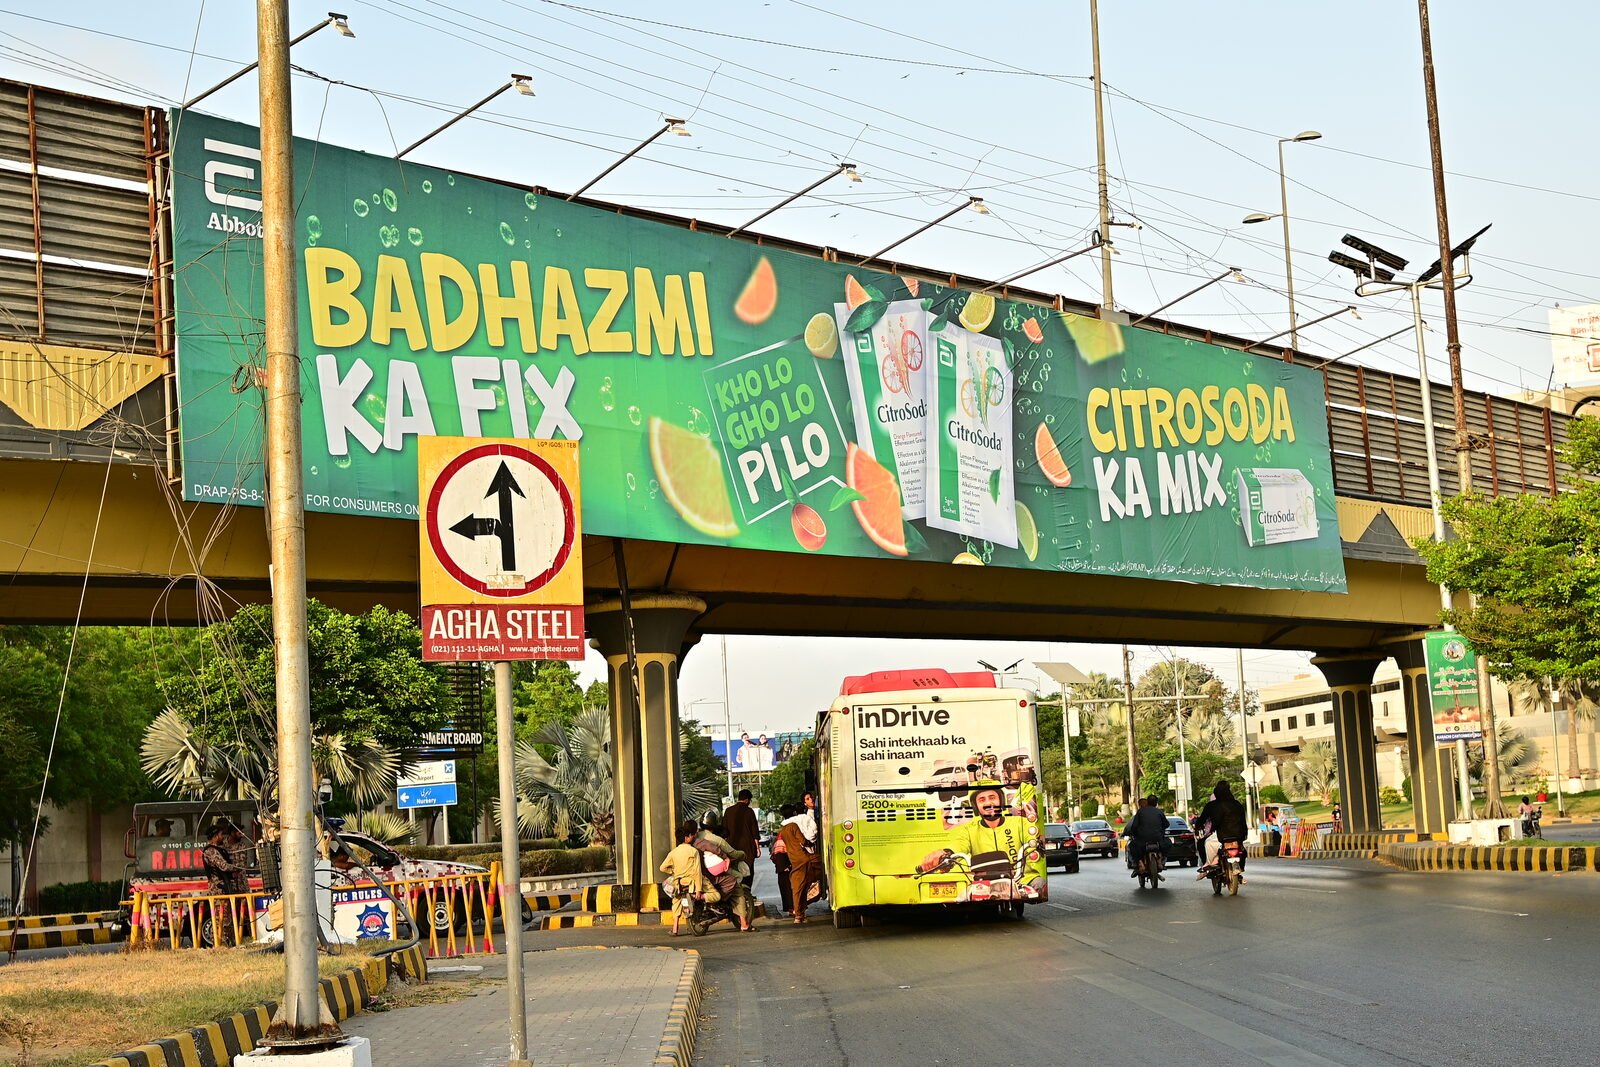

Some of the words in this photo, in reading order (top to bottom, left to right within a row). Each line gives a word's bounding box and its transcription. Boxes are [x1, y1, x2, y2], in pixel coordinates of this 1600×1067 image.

[206, 211, 264, 239] Abbot
[304, 247, 713, 357] BADHAZMI
[714, 369, 762, 413] KHO
[763, 357, 793, 391] LO
[315, 353, 436, 456] KA
[451, 355, 584, 441] FIX
[725, 399, 780, 450] GHO
[781, 383, 815, 423] LO
[1086, 383, 1296, 454] CITROSODA
[948, 420, 1002, 451] CitroSoda
[737, 441, 783, 505] PI
[780, 422, 830, 481] LO
[1092, 456, 1152, 522] KA
[1156, 450, 1227, 516] MIX
[306, 494, 330, 507] FOR
[332, 496, 402, 515] CONSUMERS
[404, 503, 420, 516] ON
[1257, 509, 1295, 525] CitroSoda
[429, 609, 501, 640] AGHA
[506, 609, 580, 640] STEEL
[431, 644, 450, 654] (021)
[451, 644, 500, 653] 111-11-AGHA
[509, 644, 579, 653] www.aghasteel.com
[857, 704, 950, 729] inDrive
[453, 732, 483, 745] BOARD
[859, 737, 886, 749] Sahi
[888, 735, 950, 748] intekhaab
[951, 734, 966, 746] ka
[860, 749, 885, 761] sahi
[887, 749, 925, 761] inaam
[861, 800, 895, 810] 2500+
[151, 849, 205, 870] RANG
[1004, 828, 1018, 863] nDrive
[351, 889, 383, 902] RULES
